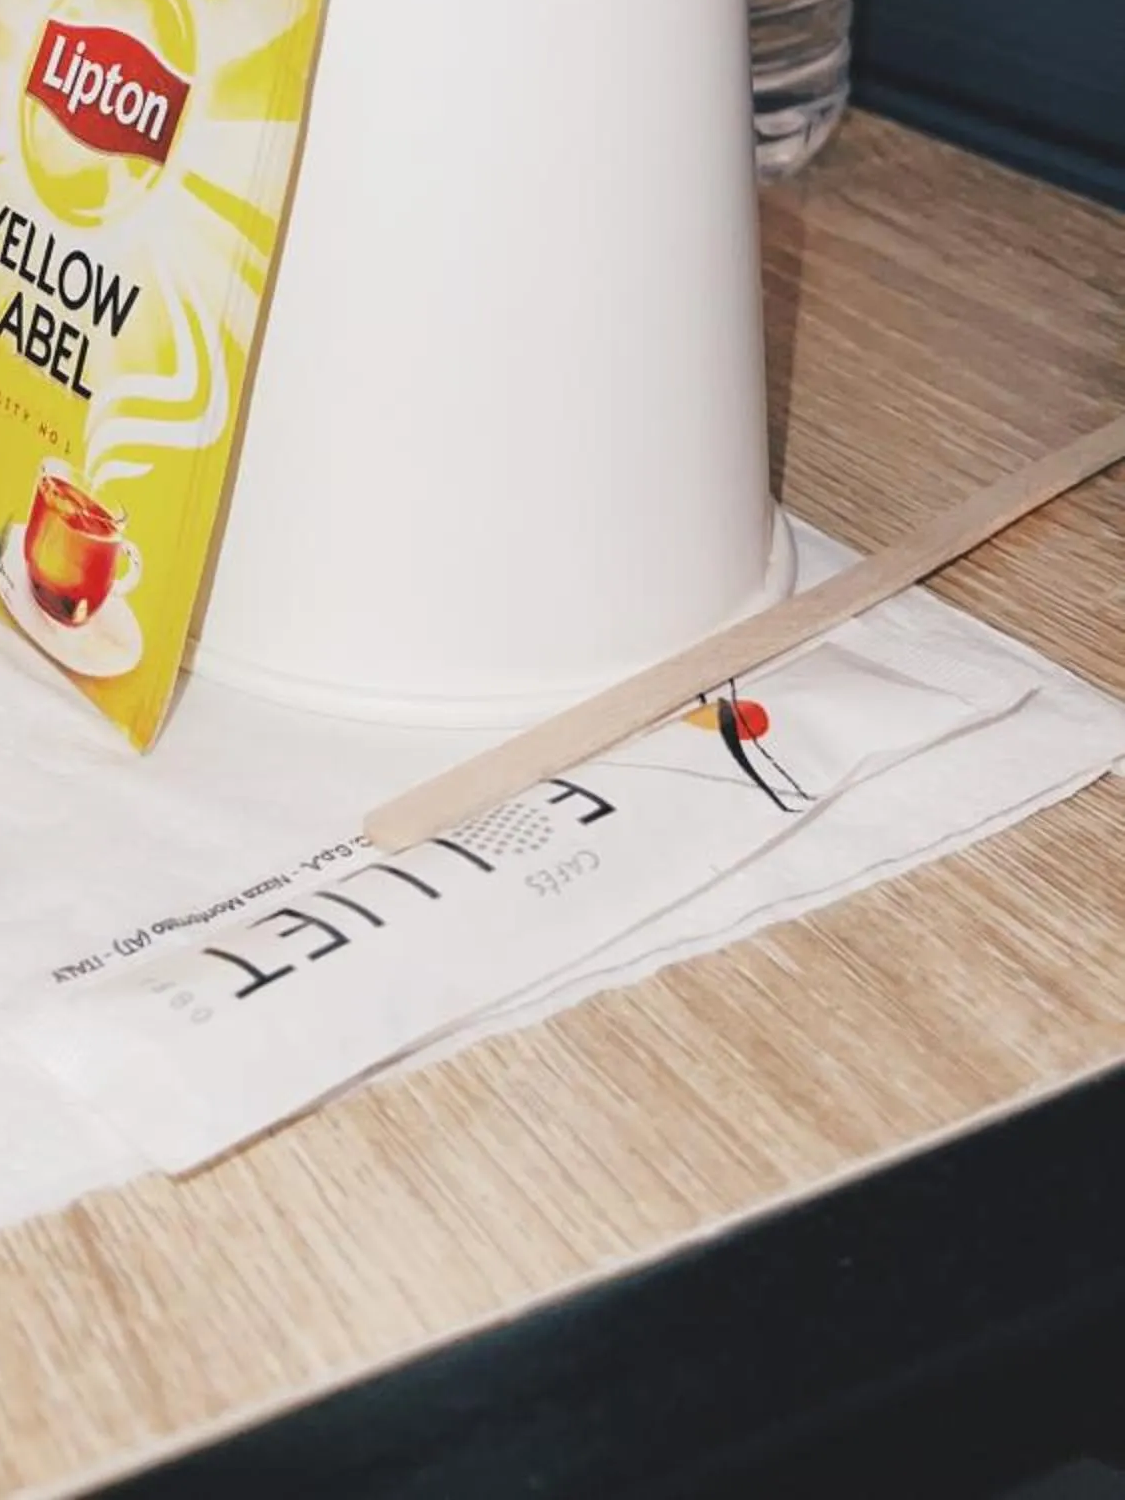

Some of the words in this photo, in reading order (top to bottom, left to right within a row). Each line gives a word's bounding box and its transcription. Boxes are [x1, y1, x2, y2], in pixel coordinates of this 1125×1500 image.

[43, 35, 169, 141] Lipton
[241, 873, 292, 900] Nizza
[51, 954, 106, 984] ITALY
